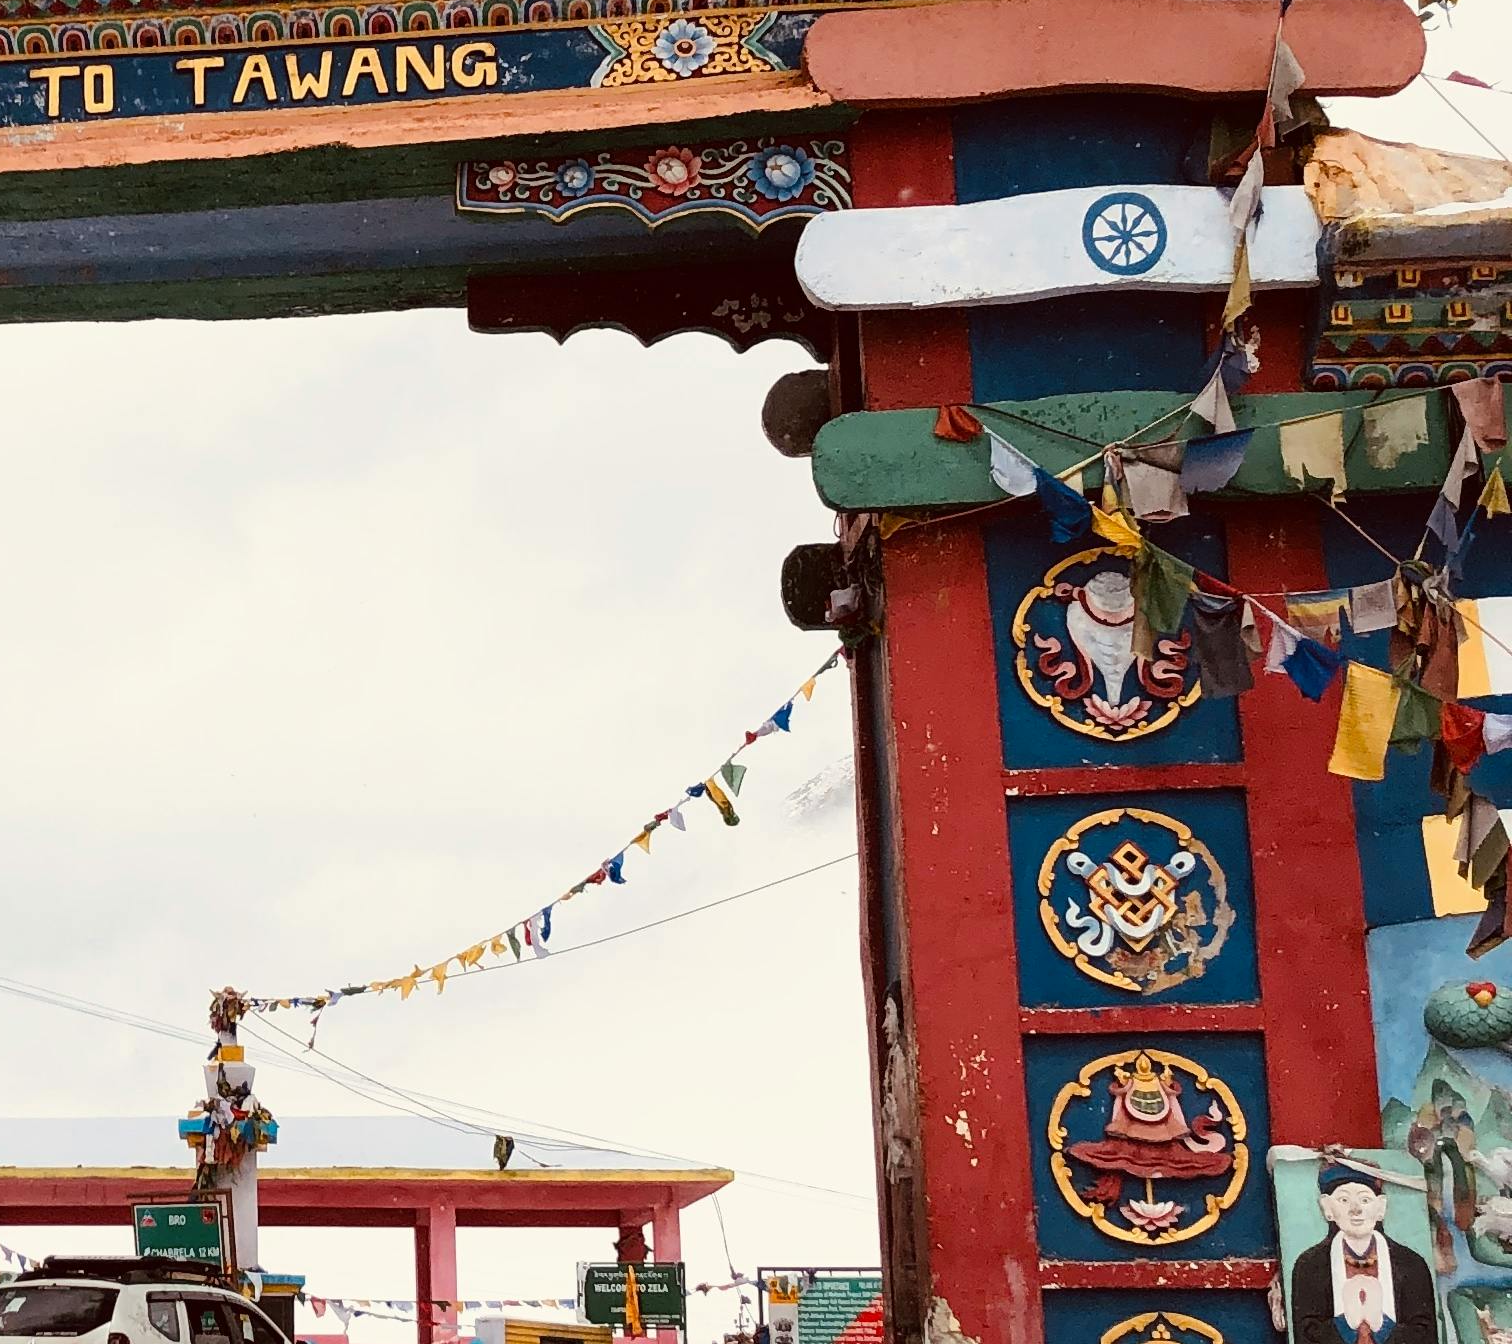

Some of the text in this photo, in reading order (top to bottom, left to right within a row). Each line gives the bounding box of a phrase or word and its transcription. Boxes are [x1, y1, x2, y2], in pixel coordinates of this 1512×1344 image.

[29, 63, 115, 117] TO
[176, 42, 498, 106] TAWANG
[168, 1215, 186, 1226] BRO
[593, 1283, 628, 1293] WELCOM
